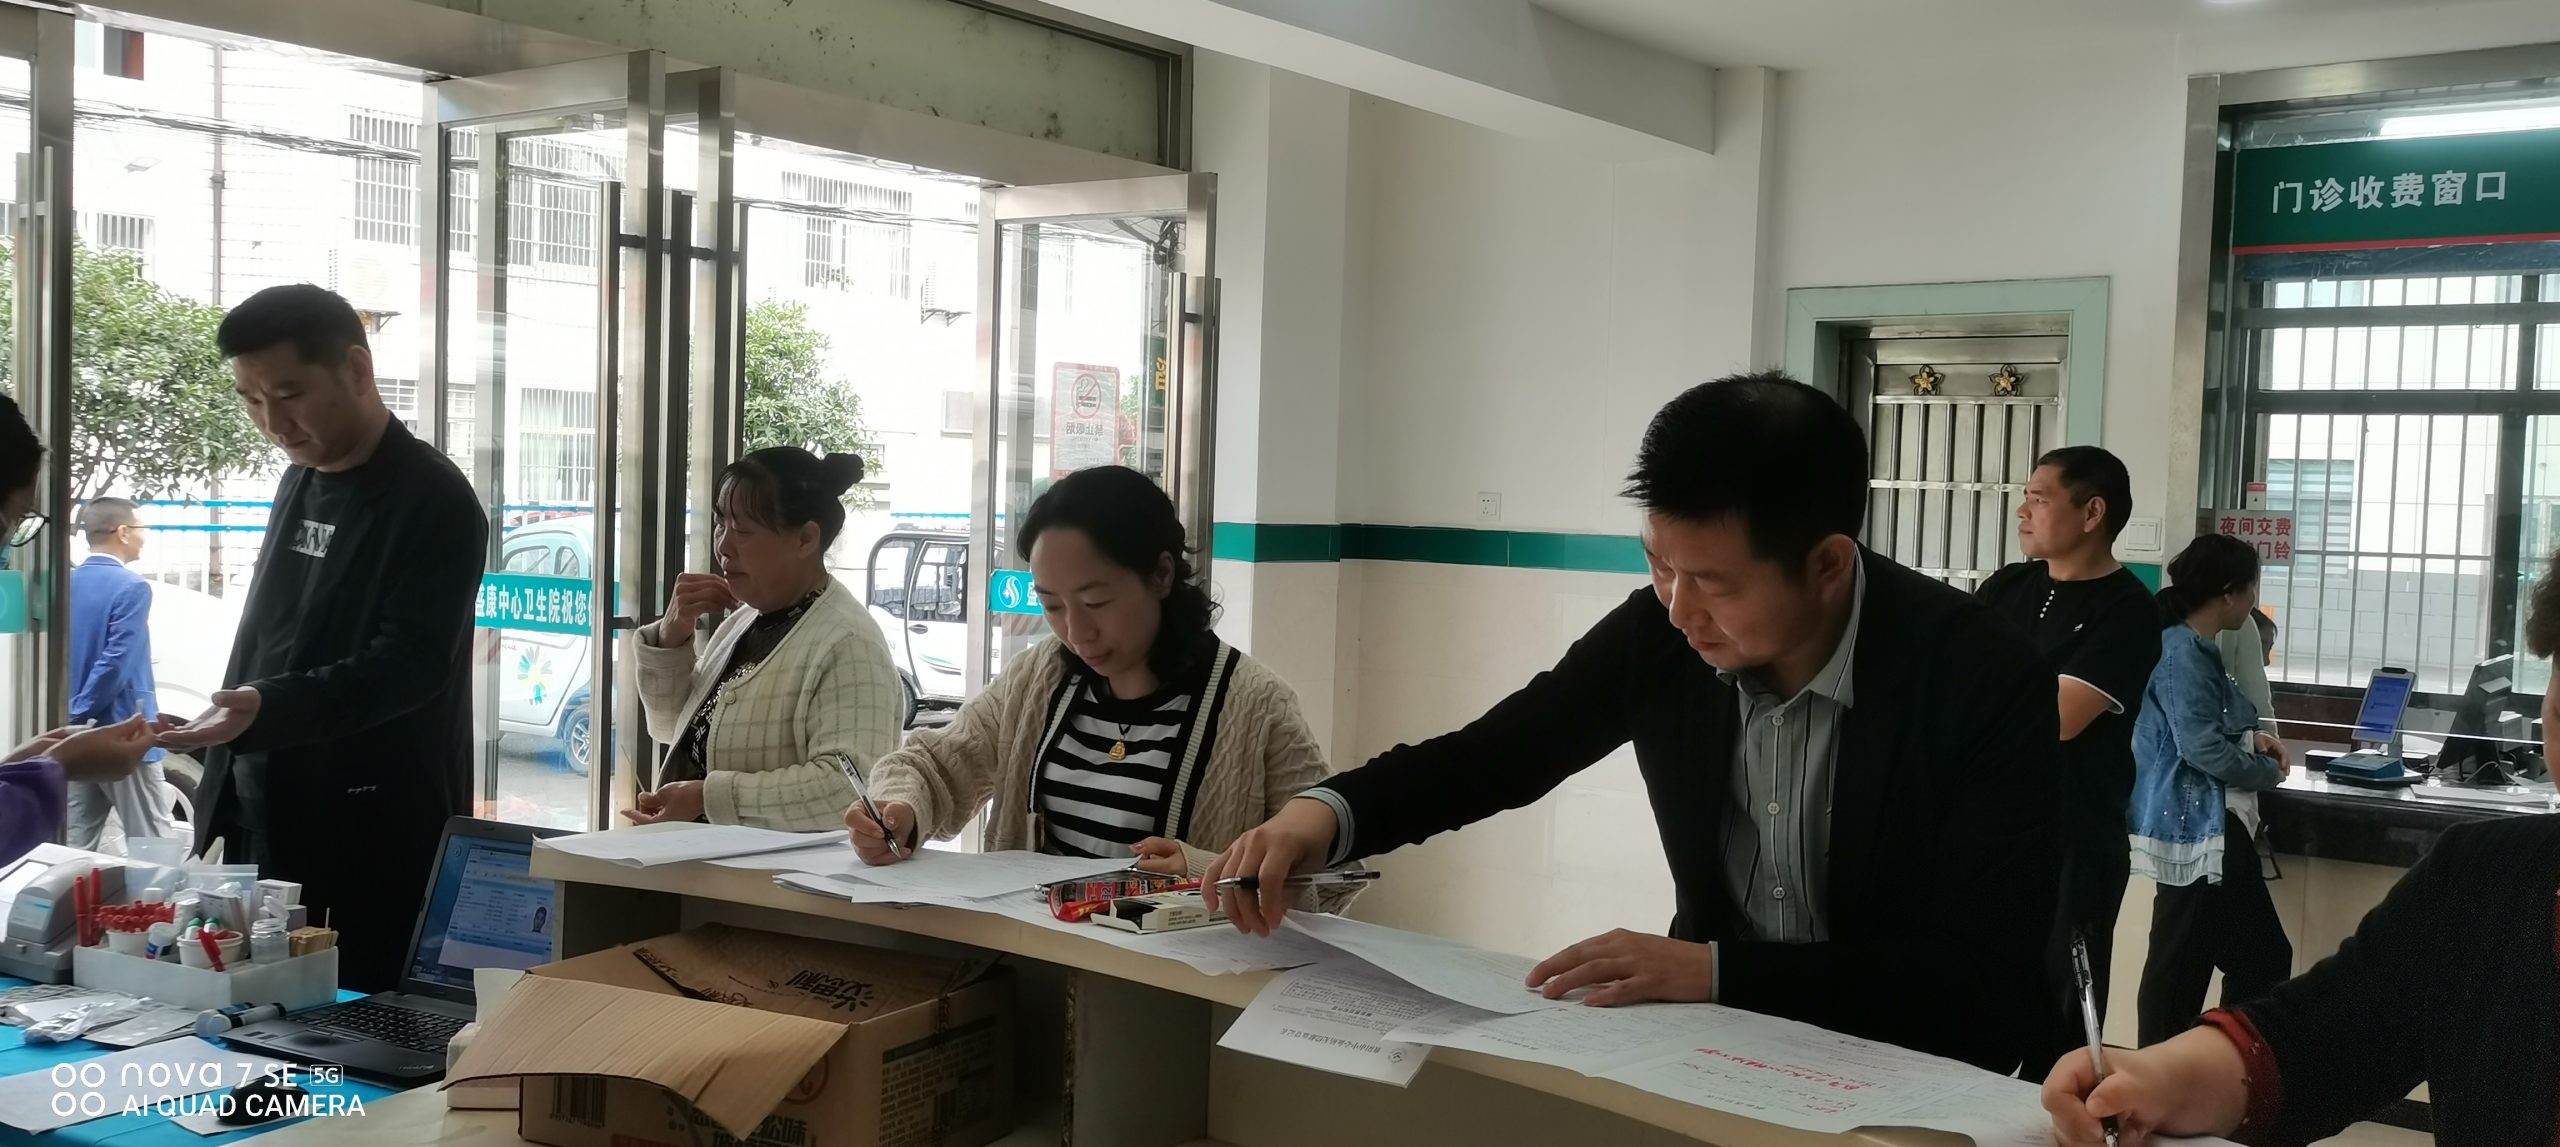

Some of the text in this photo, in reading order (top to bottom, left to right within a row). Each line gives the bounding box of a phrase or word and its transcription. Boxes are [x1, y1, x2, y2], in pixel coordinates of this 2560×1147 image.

[2272, 170, 2507, 214] 门诊收费窗口
[2220, 516, 2292, 537] 夜间交费
[2247, 541, 2291, 560] 门铃
[475, 583, 593, 625] 盛康中心卫生院祝您
